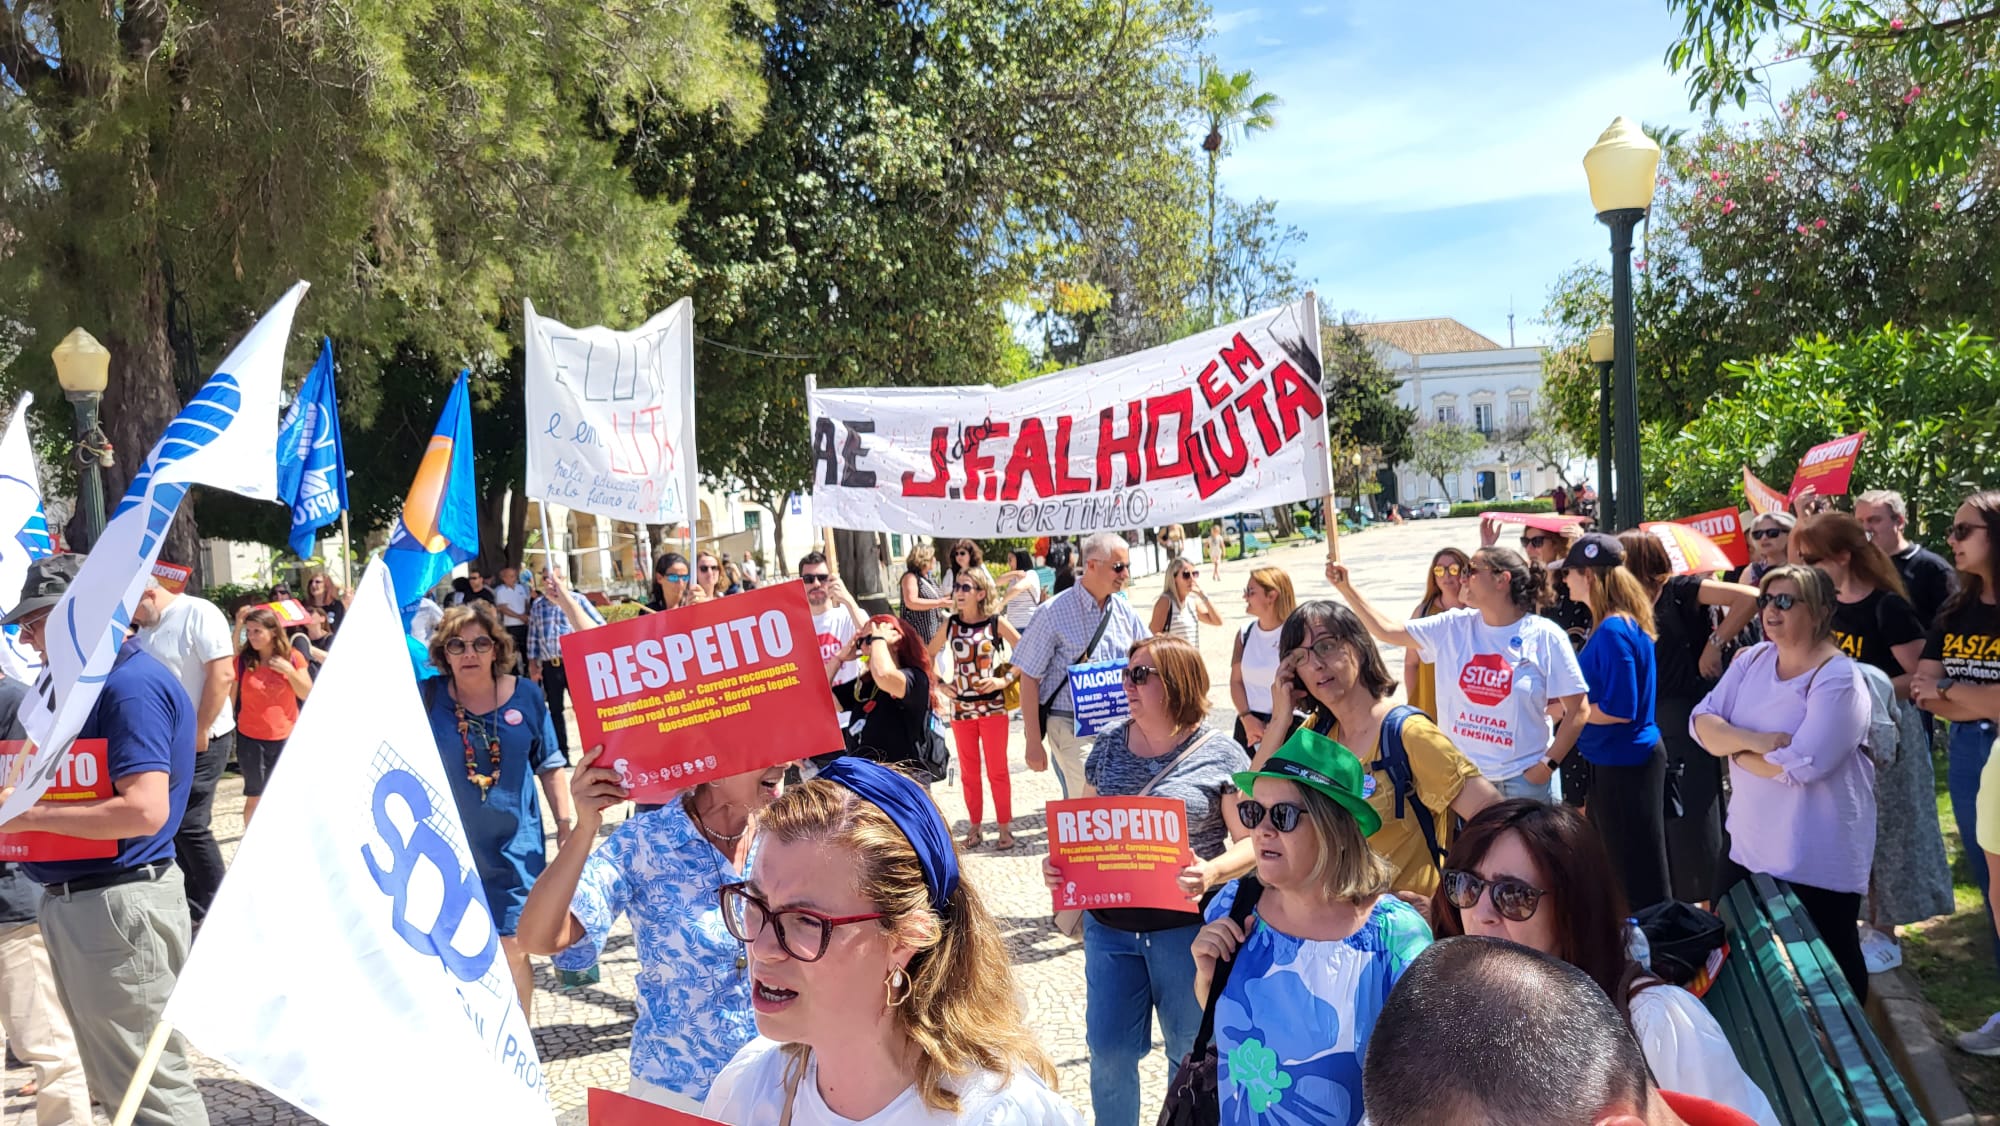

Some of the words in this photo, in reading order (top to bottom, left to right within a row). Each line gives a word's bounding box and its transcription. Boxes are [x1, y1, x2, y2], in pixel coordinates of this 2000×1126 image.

[1196, 332, 1264, 409] EM
[544, 412, 561, 439] e
[570, 421, 604, 447] em
[608, 406, 675, 475] LUTA
[814, 417, 877, 488] AE
[1185, 360, 1325, 500] LUTA
[1802, 438, 1859, 468] RESPEITO
[584, 610, 794, 702] RESPEITO
[597, 695, 664, 719] Precariedade,
[664, 689, 687, 705] não!
[696, 676, 738, 695] Carreira
[738, 662, 799, 685] recomposta.
[602, 714, 645, 733] Aumento
[645, 709, 667, 722] real
[667, 705, 680, 716] do
[680, 696, 719, 714] salário.
[724, 683, 767, 701] Horários
[767, 675, 801, 693] legais.
[658, 709, 722, 733] Aposentação
[722, 700, 752, 718] justa!
[1460, 712, 1466, 721] A
[1469, 713, 1508, 729] LUTAR
[1461, 728, 1514, 747] ENSINAR
[1056, 808, 1180, 843] RESPEITO
